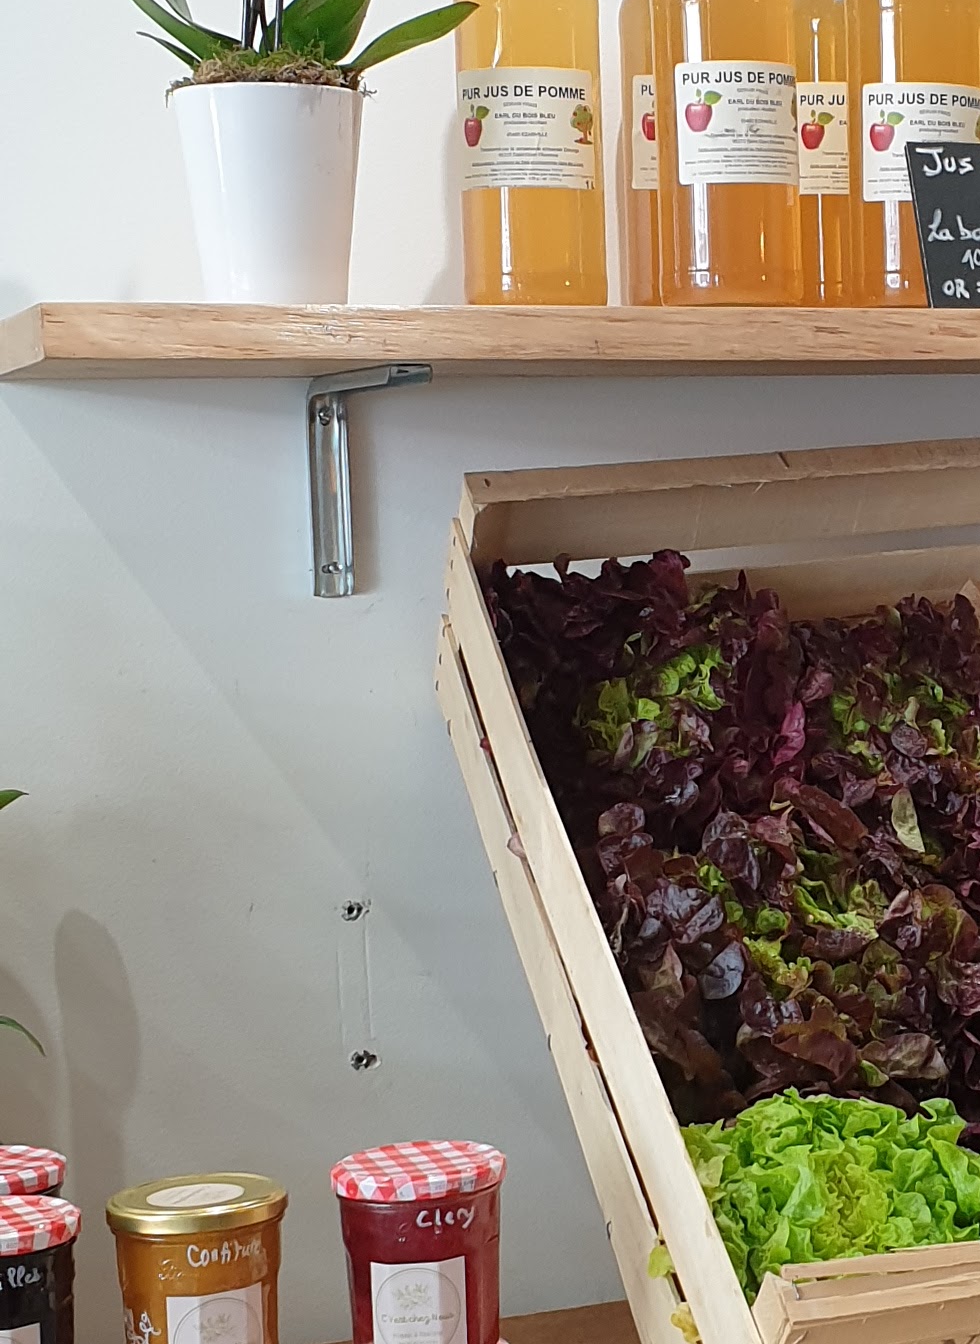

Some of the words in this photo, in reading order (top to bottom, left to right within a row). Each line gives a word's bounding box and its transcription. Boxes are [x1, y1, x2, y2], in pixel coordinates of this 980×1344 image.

[682, 71, 711, 85] PUR
[714, 71, 743, 84] JUS
[747, 71, 766, 84] DE
[462, 87, 481, 101] PUR
[483, 85, 509, 98] JUS
[513, 85, 534, 97] DE
[538, 85, 586, 101] POMME
[641, 84, 655, 96] PU
[800, 94, 824, 106] PUR
[828, 94, 845, 106] JU
[868, 93, 894, 106] PUR
[897, 92, 925, 105] JUS
[929, 93, 948, 106] DE
[915, 146, 975, 177] Jus
